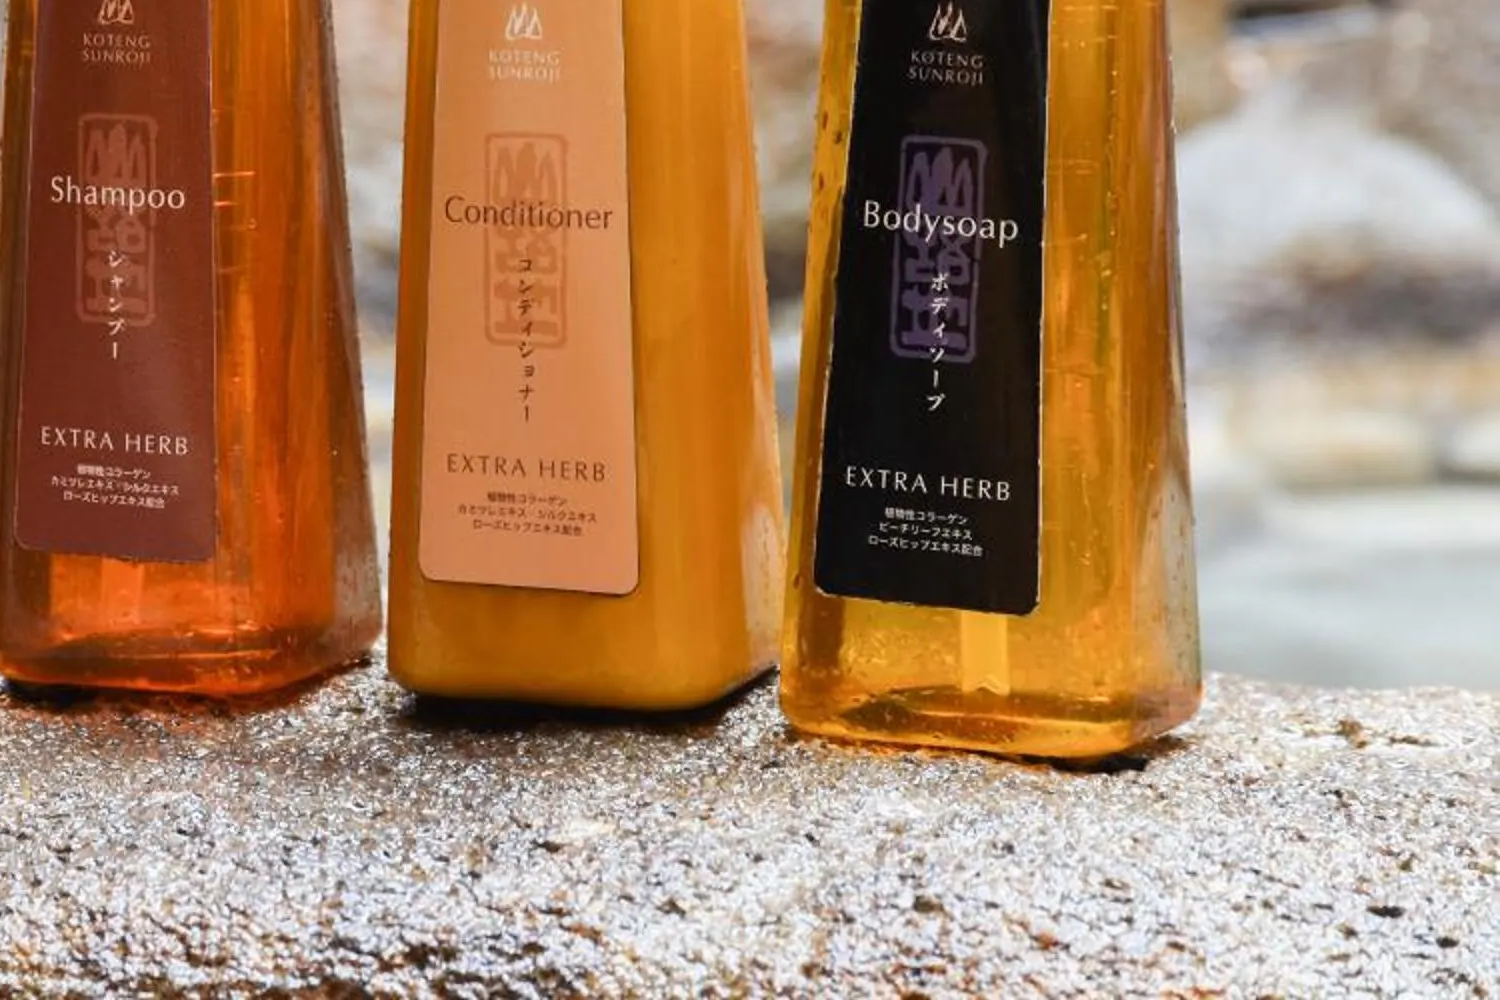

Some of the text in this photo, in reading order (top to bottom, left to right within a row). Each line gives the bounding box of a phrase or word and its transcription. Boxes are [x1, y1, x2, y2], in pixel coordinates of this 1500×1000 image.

[82, 33, 151, 49] KOTENG
[488, 48, 561, 66] KOTENG
[910, 49, 985, 69] KOTENG
[907, 66, 985, 86] SUNROJI
[50, 175, 186, 216] Shampoo
[444, 195, 614, 230] Conditioner
[862, 199, 1020, 249] Bodysoap
[108, 250, 127, 360] シャンプー
[517, 257, 536, 423] コンディショナー
[40, 425, 190, 457] EXTRA HERB
[447, 452, 607, 483] EXTRA HERB
[845, 465, 1012, 502] EXTRA HERB
